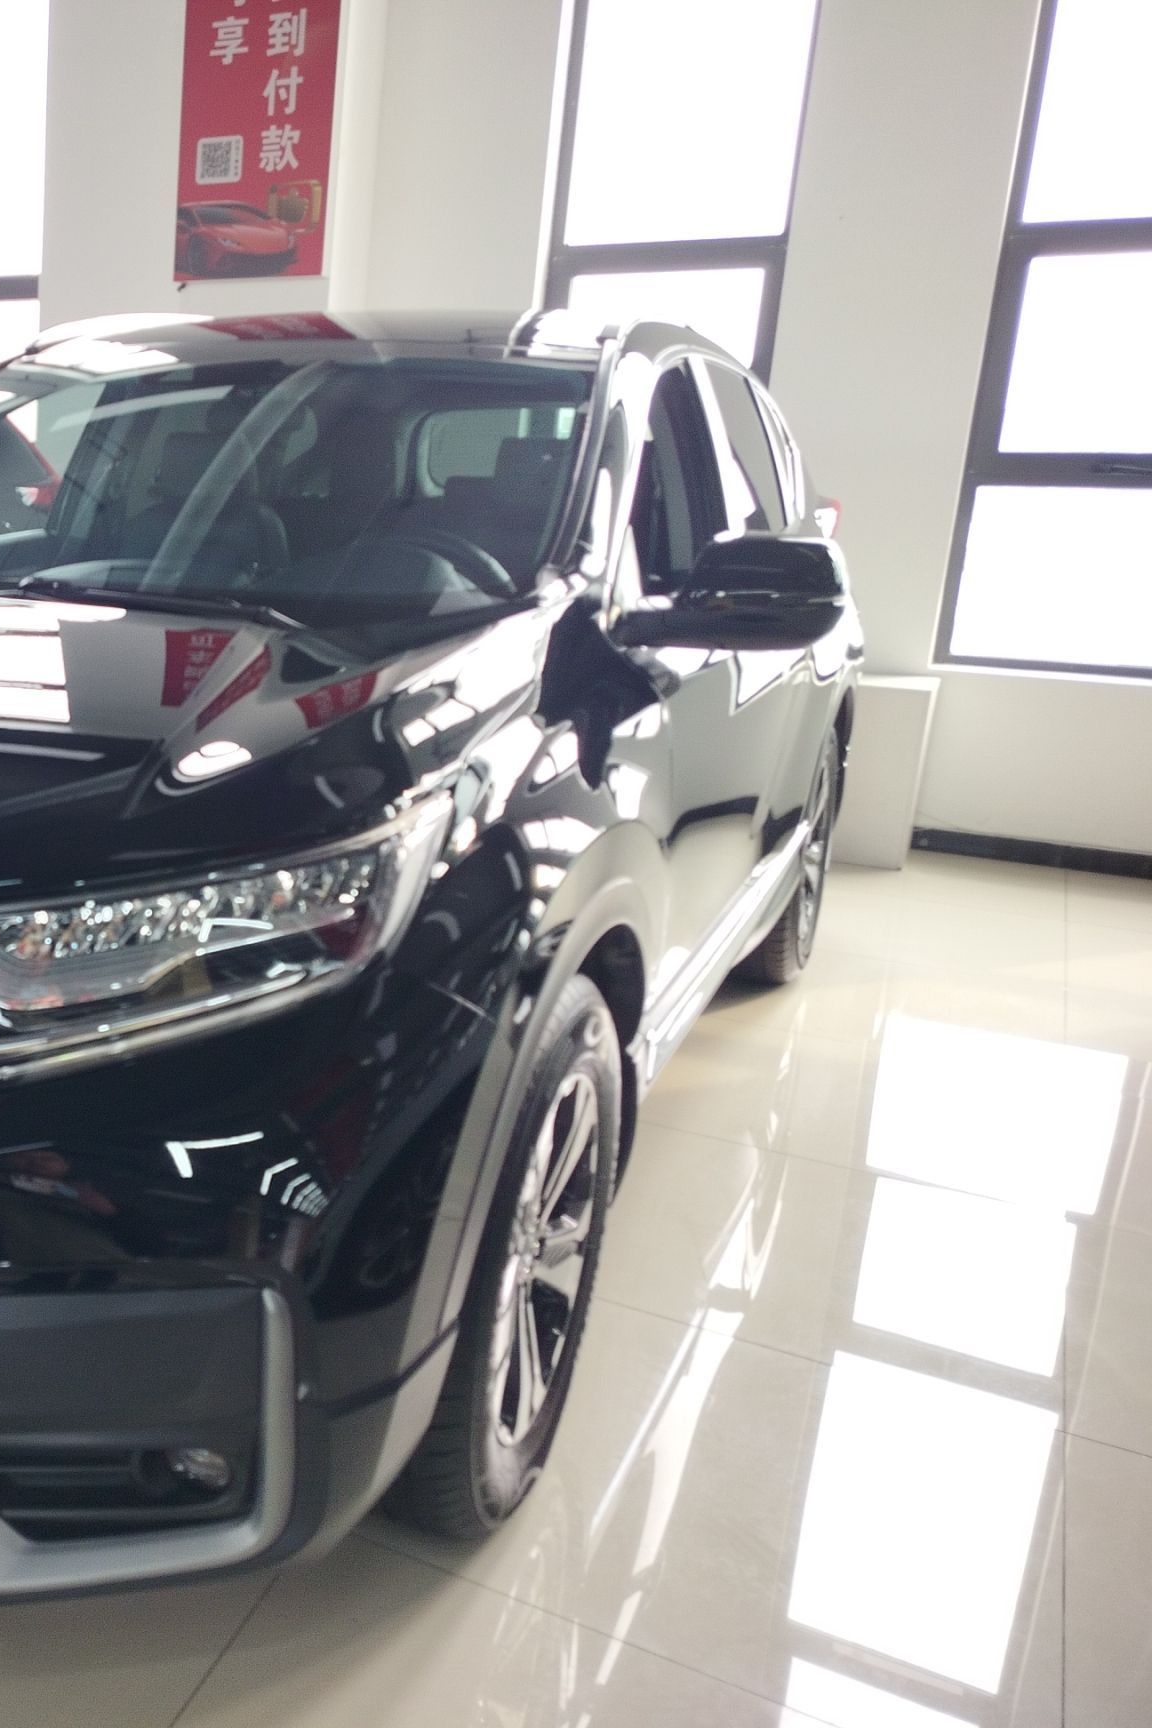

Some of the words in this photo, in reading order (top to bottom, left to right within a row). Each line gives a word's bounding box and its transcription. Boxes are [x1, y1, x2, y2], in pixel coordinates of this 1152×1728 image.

[209, 0, 250, 65] 享
[258, 0, 308, 174] 到付款
